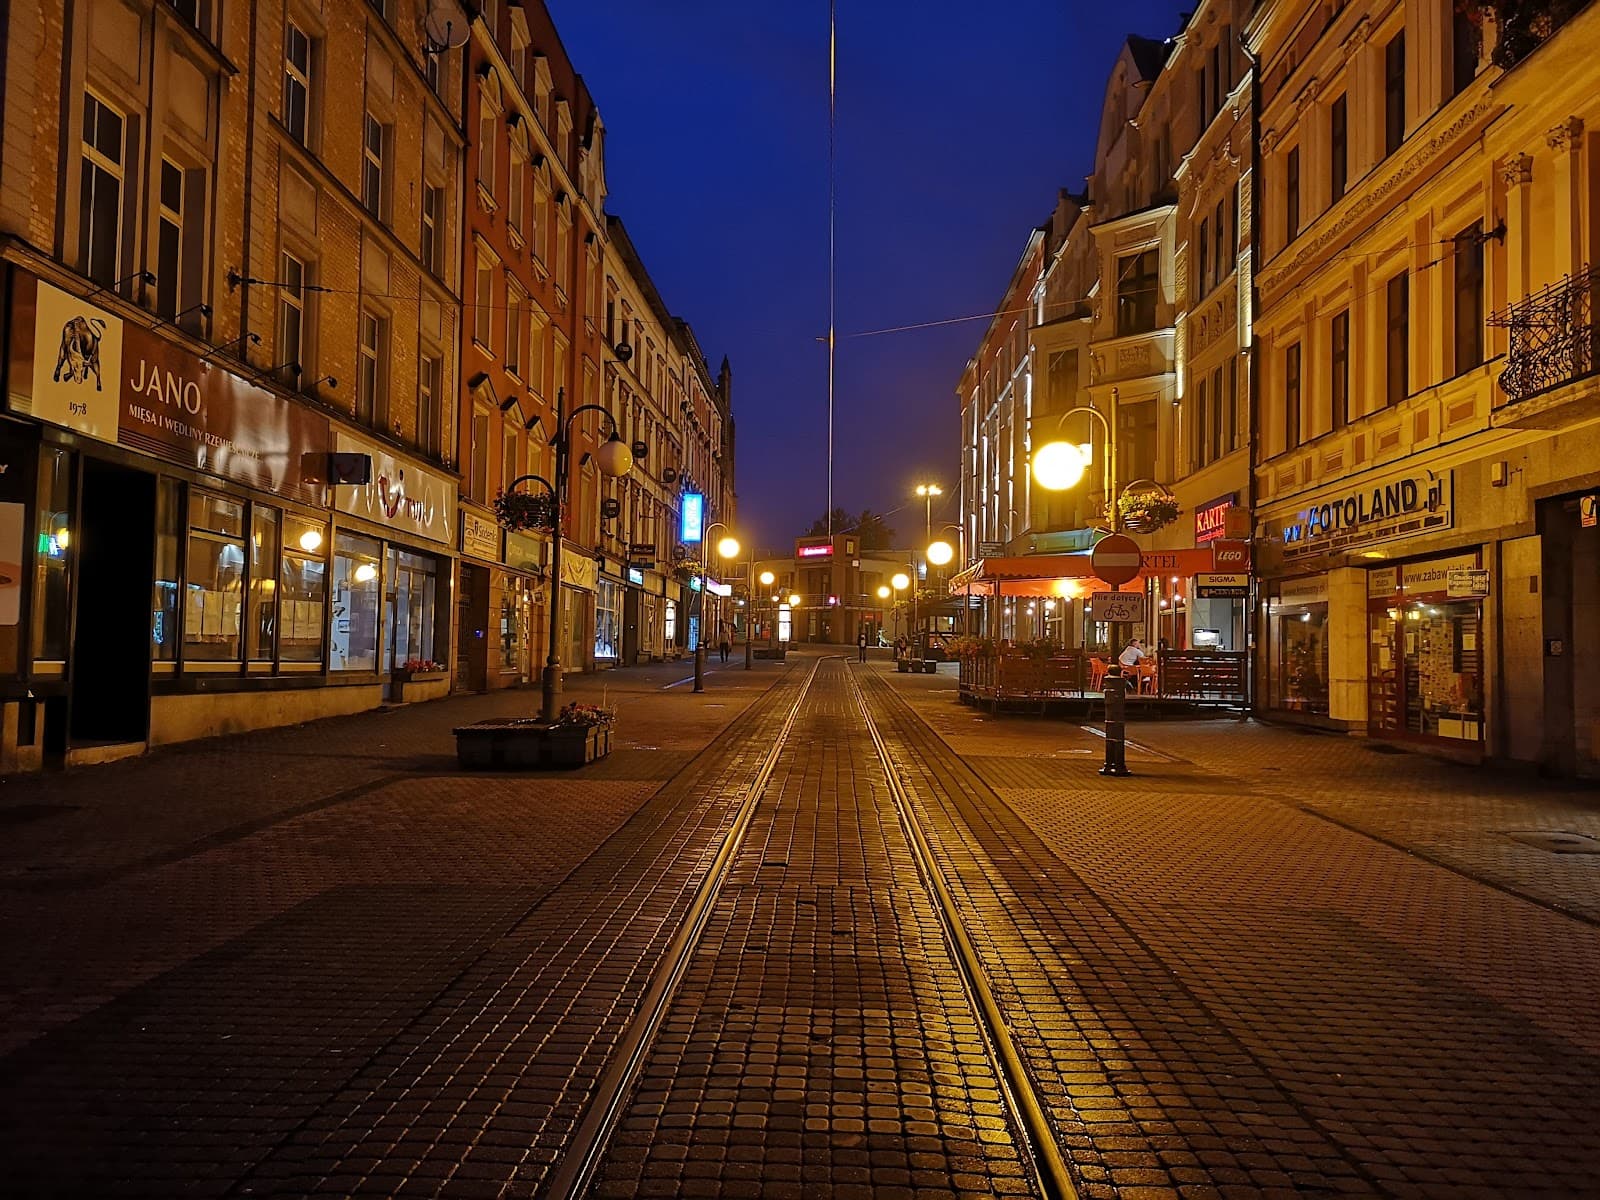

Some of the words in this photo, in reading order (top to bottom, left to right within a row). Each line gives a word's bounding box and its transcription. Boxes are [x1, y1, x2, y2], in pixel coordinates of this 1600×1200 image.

[130, 359, 202, 415] JANO
[68, 400, 88, 416] 1978
[128, 403, 157, 427] MIĘSA
[158, 416, 164, 429] I
[164, 418, 203, 443] WĘDLINY
[1196, 502, 1230, 533] KARTE
[1141, 555, 1180, 569] RTEL
[1217, 550, 1242, 561] LEGO
[1208, 575, 1236, 583] SIGMA
[1094, 593, 1108, 601] Nie
[1111, 593, 1140, 602] dotyczy
